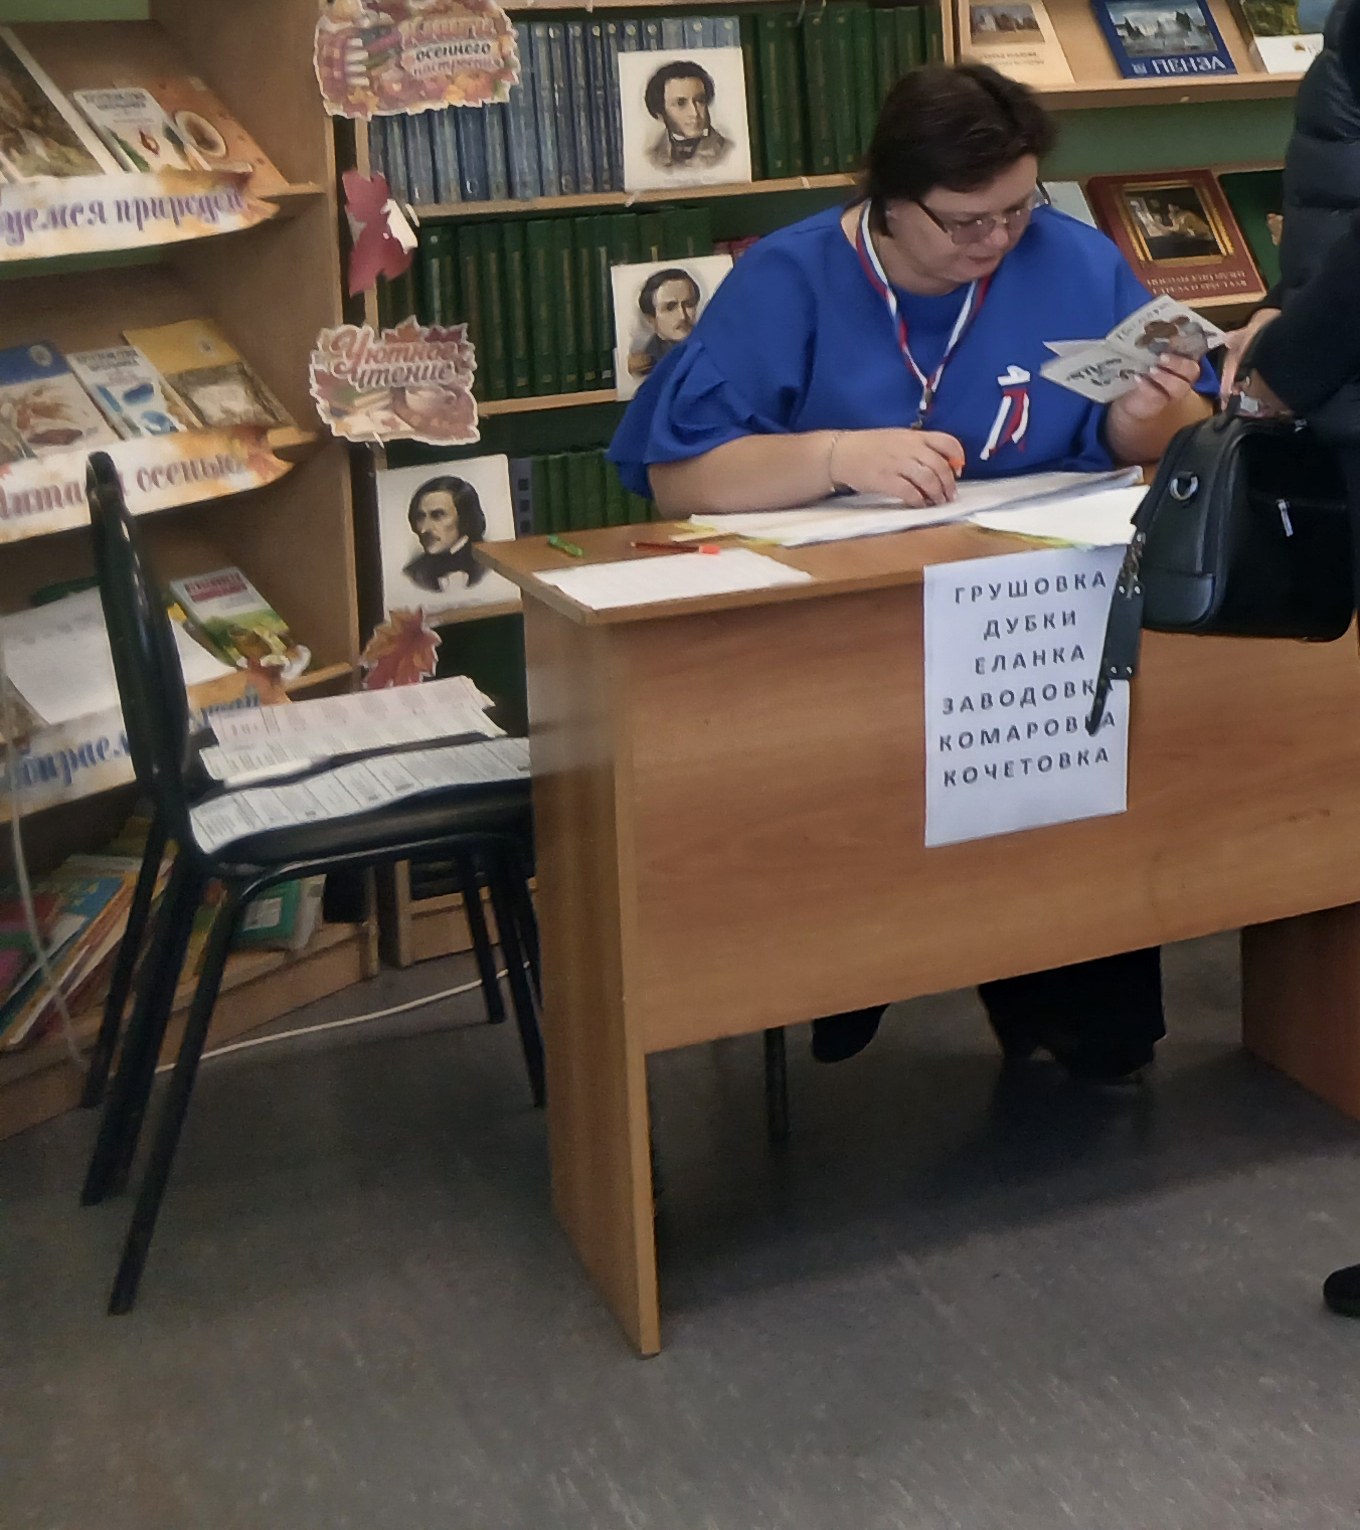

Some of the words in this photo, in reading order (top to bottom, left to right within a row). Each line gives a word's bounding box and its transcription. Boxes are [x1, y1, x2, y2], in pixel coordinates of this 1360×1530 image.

[415, 41, 492, 62] осеннего
[1152, 56, 1227, 75] ПЕНЗА
[954, 570, 1107, 604] ГРУШОВКА
[983, 610, 1076, 641] ДУБКИ
[974, 643, 1086, 675] ЕЛАНКА
[943, 746, 1110, 788] КОЧЕТОВКА
